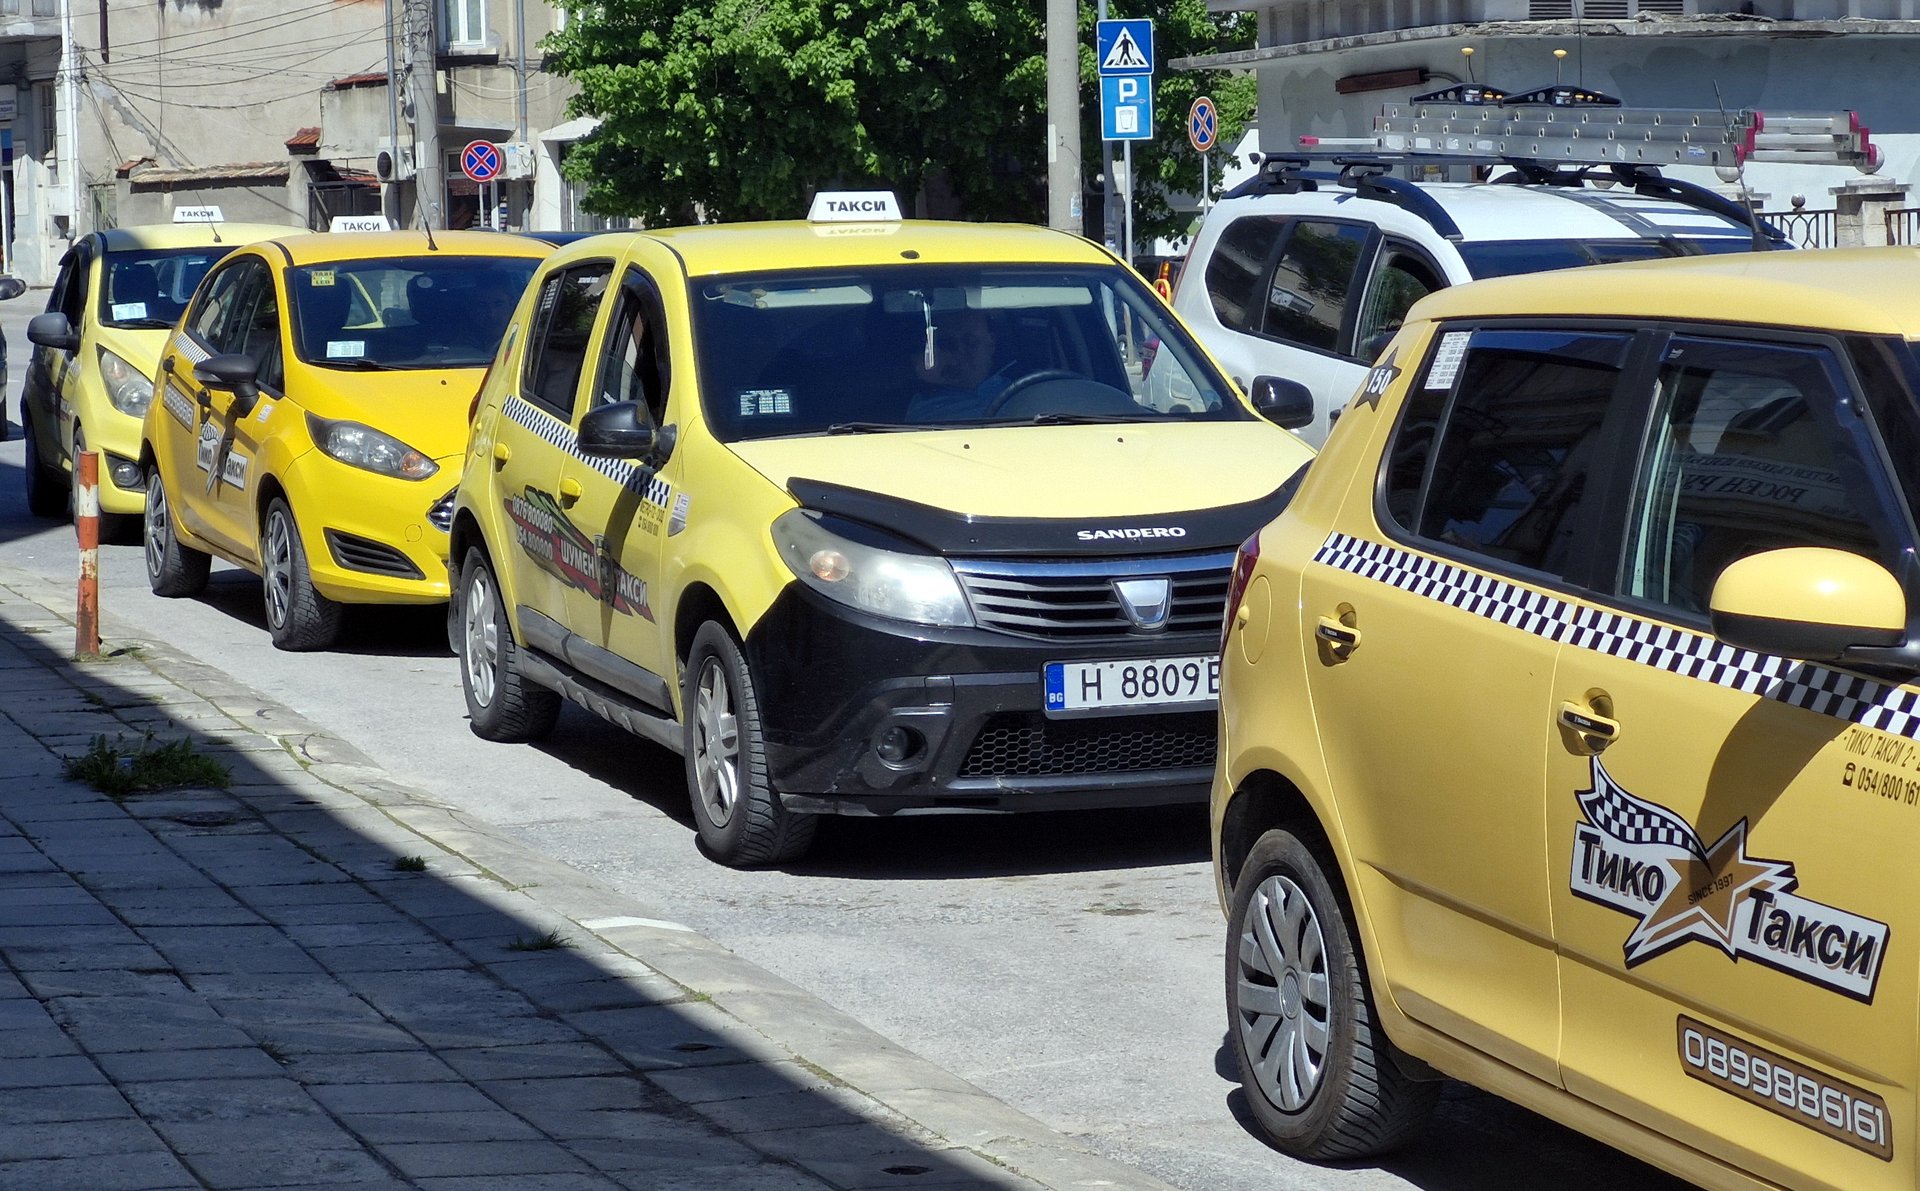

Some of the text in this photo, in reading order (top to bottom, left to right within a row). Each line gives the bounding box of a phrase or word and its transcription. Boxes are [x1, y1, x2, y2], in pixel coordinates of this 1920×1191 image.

[1118, 78, 1138, 103] P
[181, 210, 214, 218] ТАКСИ
[826, 200, 887, 212] ТАКСИ
[342, 221, 380, 232] ТАКСИ
[1366, 368, 1393, 395] 150
[1077, 526, 1187, 541] SANDERO
[560, 538, 595, 580] ШУМЕН
[1049, 692, 1064, 703] BG
[1081, 667, 1102, 702] H
[1871, 735, 1907, 766] ТАКСИ
[1857, 766, 1903, 801] 054/800
[1578, 830, 1667, 903] Тико
[1687, 872, 1734, 906] SINCE 1997
[1747, 886, 1877, 979] Такси
[1684, 1028, 1886, 1146] 0899886161
